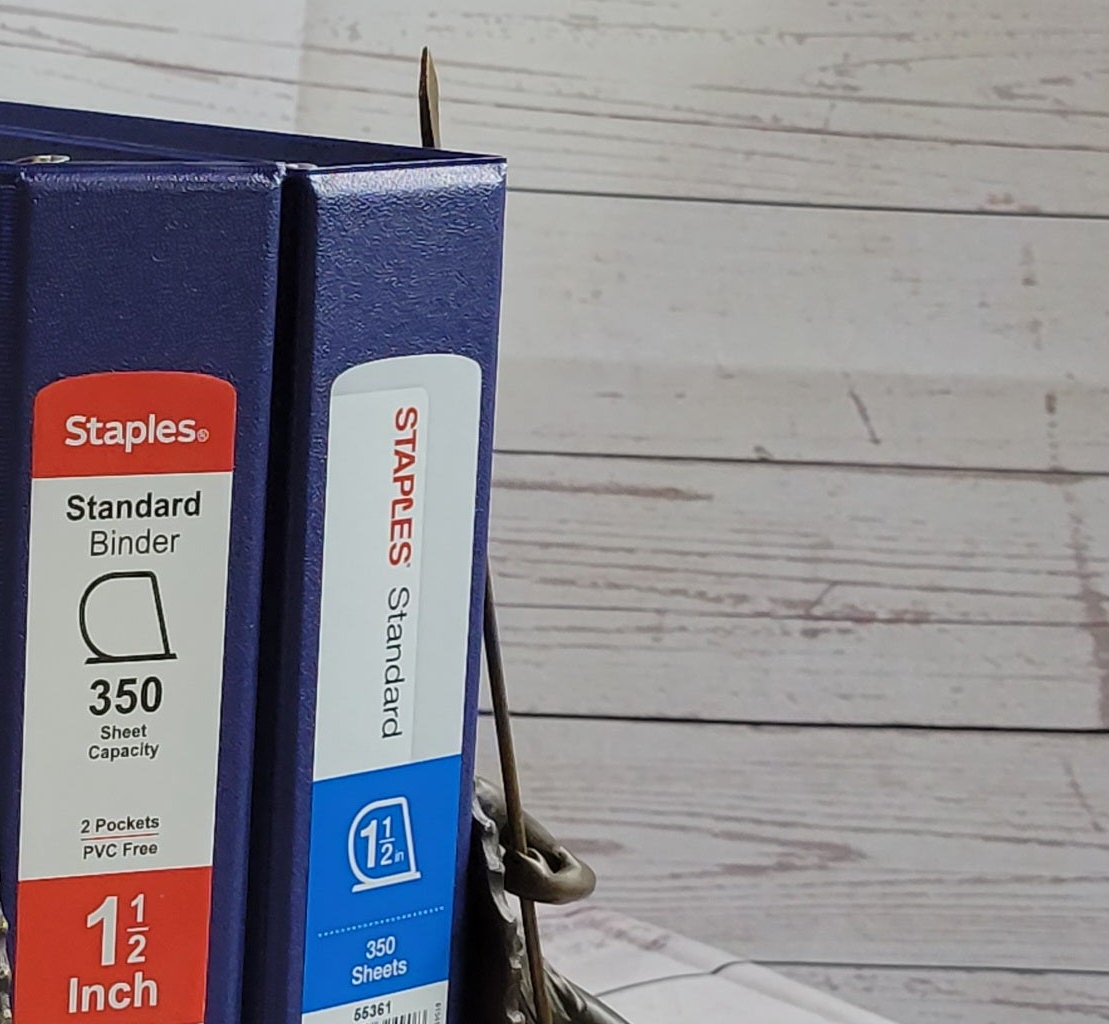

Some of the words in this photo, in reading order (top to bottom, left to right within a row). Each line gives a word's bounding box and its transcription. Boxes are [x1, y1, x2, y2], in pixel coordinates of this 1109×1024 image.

[388, 406, 418, 566] STAPLES
[66, 491, 201, 521] Standard
[90, 529, 180, 556] Binder
[381, 587, 410, 739] Standard
[89, 677, 162, 716] 350
[100, 724, 147, 740] Sheet
[88, 743, 159, 761] Capacity
[80, 819, 90, 833] 2
[95, 816, 160, 832] Pockets
[83, 844, 117, 859] PVC
[123, 841, 158, 857] Free
[365, 935, 396, 959] 350
[351, 959, 408, 986] Sheets
[68, 971, 158, 1014] Inch
[353, 1000, 392, 1021] 55361
